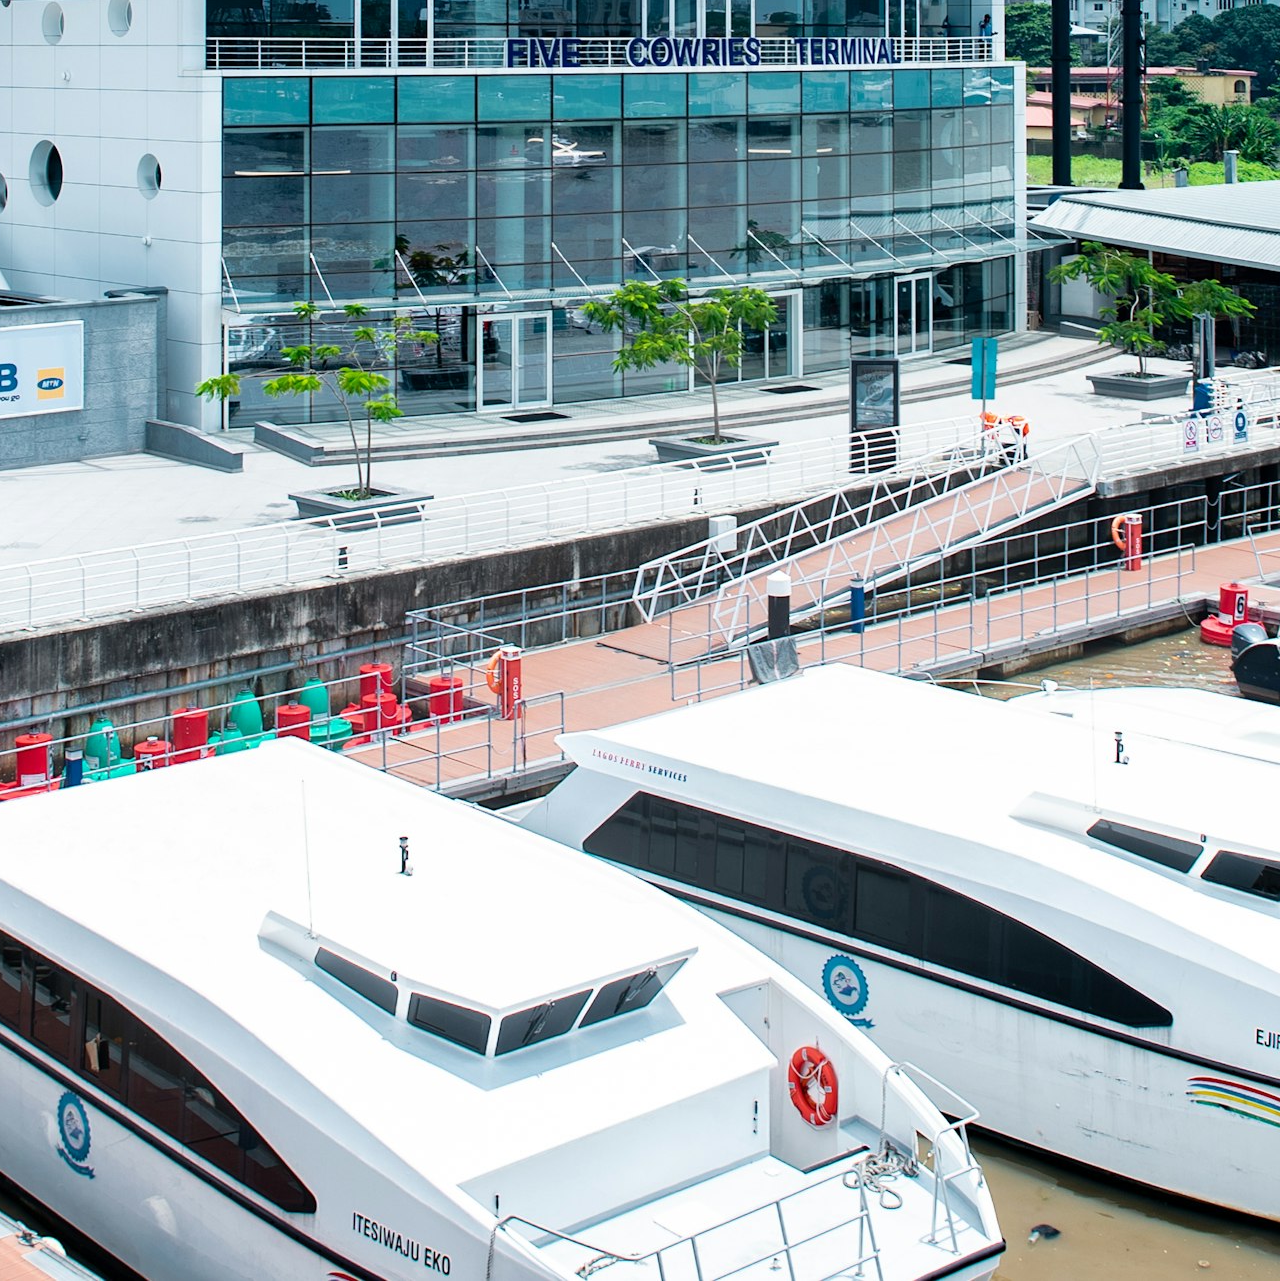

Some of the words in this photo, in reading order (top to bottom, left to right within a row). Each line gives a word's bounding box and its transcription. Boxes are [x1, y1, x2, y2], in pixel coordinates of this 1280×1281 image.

[506, 37, 582, 68] FIVE
[626, 36, 762, 66] COWRIES
[793, 36, 902, 64] TERMINAL
[40, 379, 60, 389] MTN
[10, 394, 21, 403] go
[1236, 596, 1245, 615] 6
[592, 748, 618, 763] LAGOS
[648, 765, 688, 783] SERVICES
[352, 1211, 420, 1262] ITESIWAJU
[424, 1246, 451, 1276] EKO
